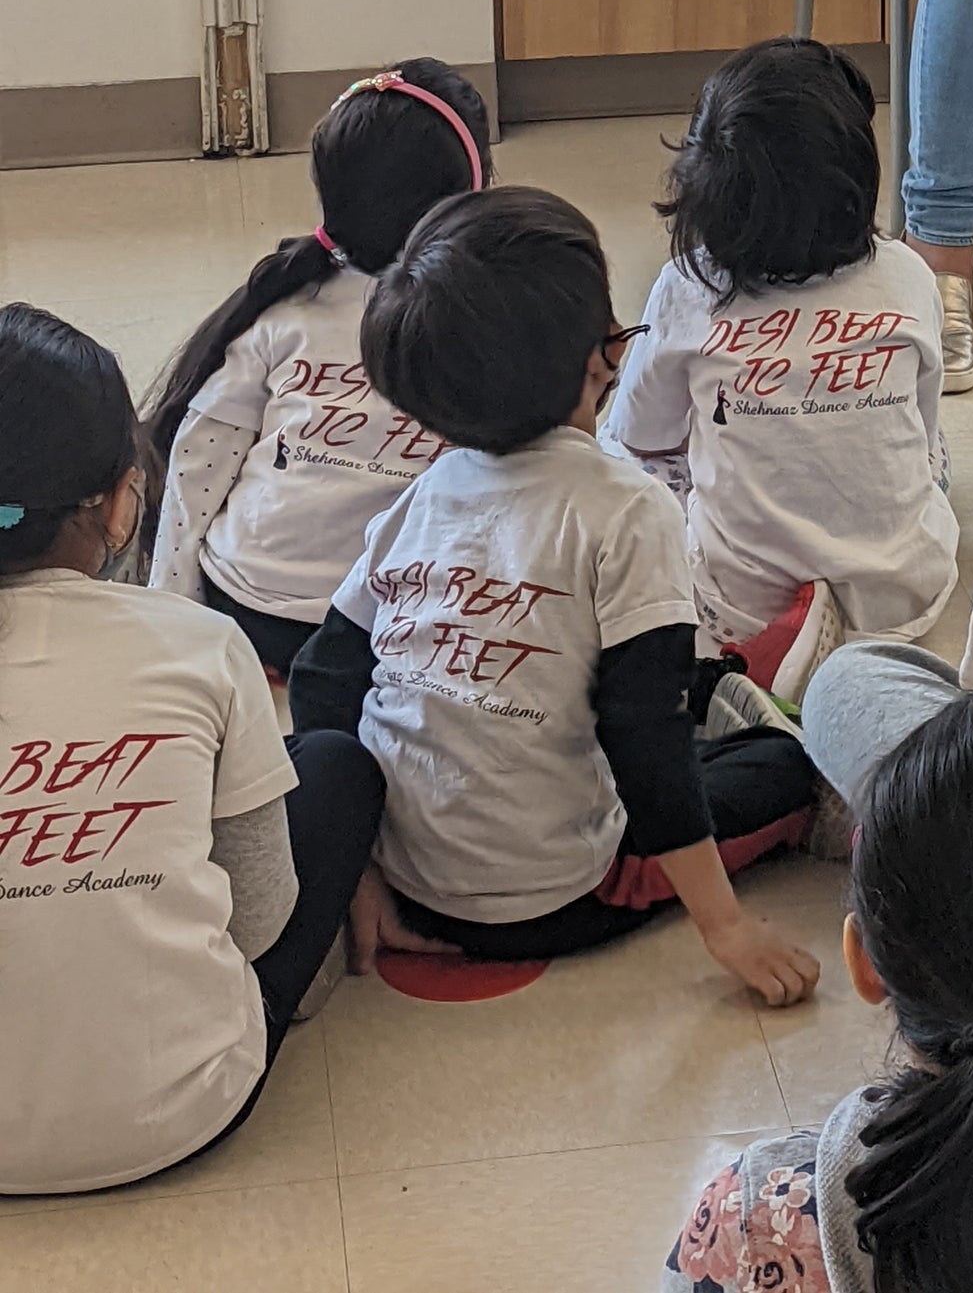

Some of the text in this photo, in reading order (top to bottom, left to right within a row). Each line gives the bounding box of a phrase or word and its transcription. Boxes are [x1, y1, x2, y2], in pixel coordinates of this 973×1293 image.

[700, 308, 919, 358] DESI BEAT
[734, 344, 912, 399] JC FEET
[299, 405, 369, 446] JC
[733, 399, 798, 416] Shehnaaz
[801, 396, 849, 414] Dance
[294, 446, 364, 470] Shehnaaz
[440, 566, 575, 627] BEAT
[422, 622, 563, 689] FEET
[463, 692, 550, 726] Academy
[0, 734, 192, 796] BEAT
[0, 800, 178, 867] FEET
[62, 868, 166, 893] Academy
